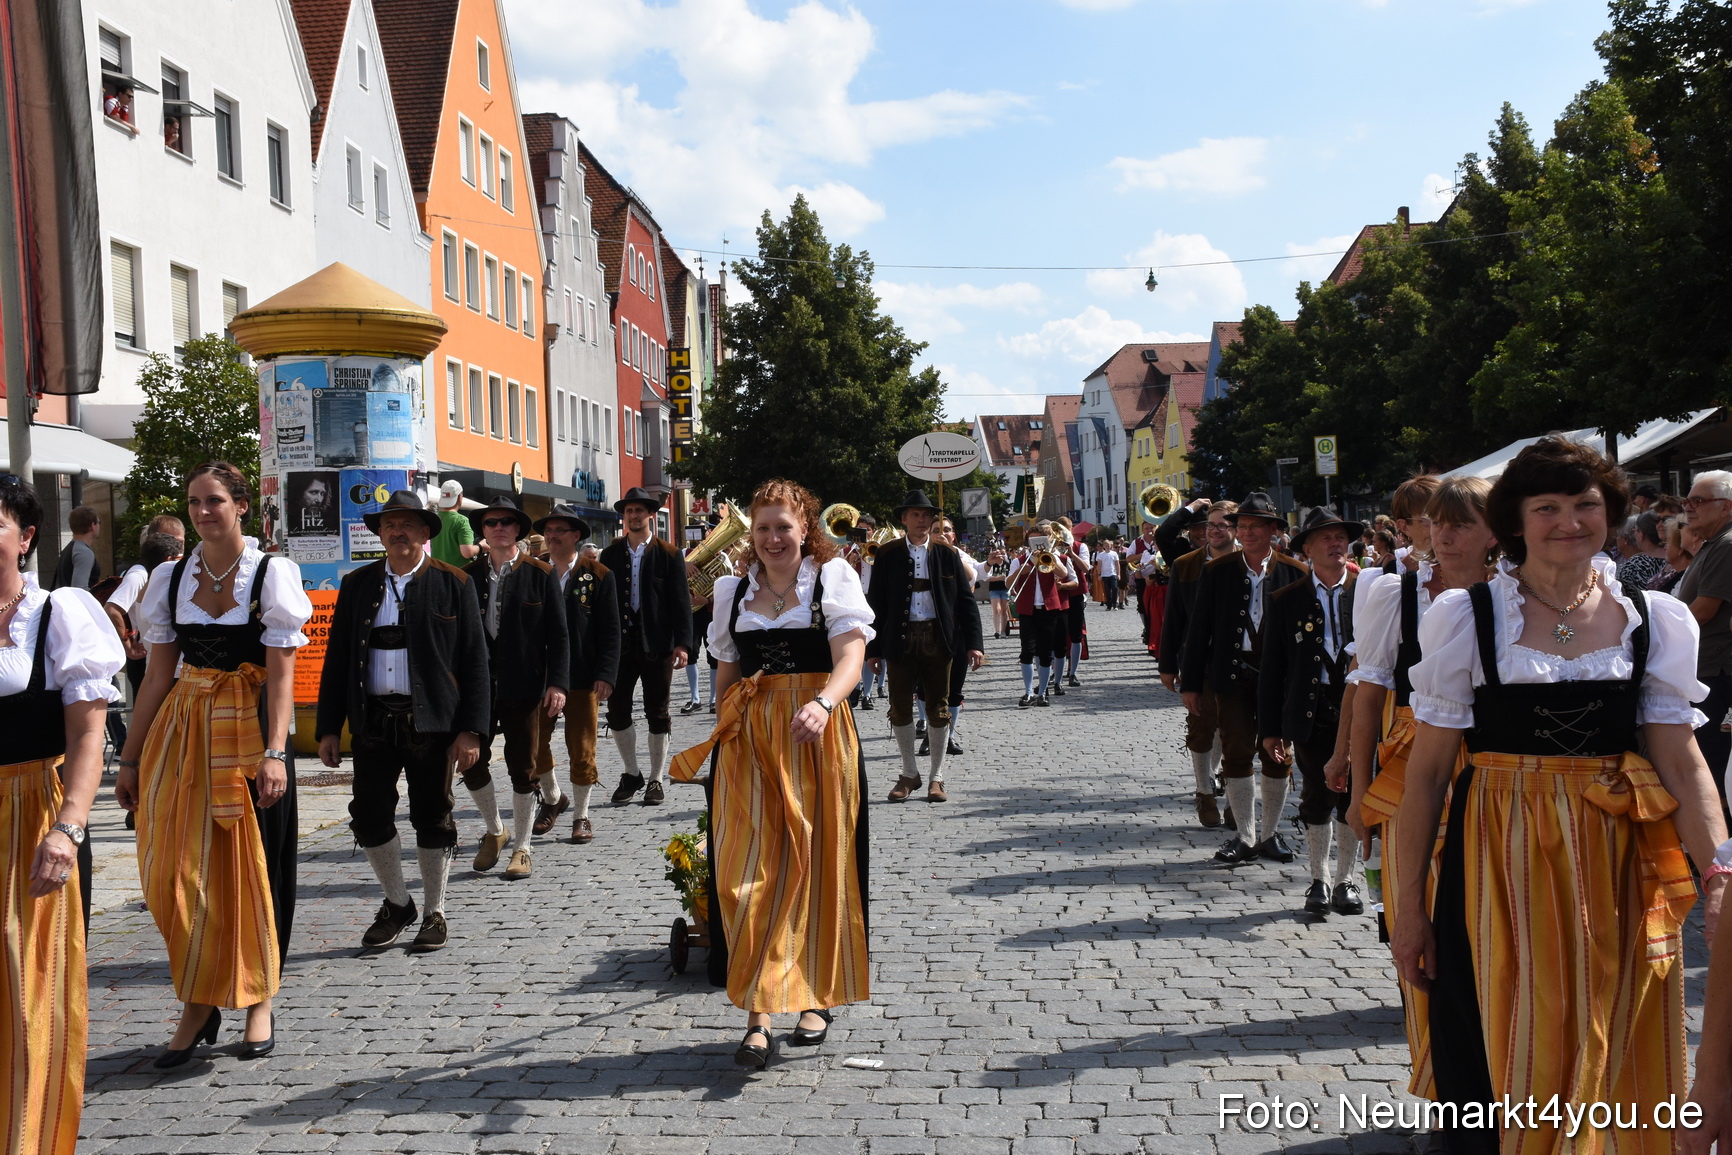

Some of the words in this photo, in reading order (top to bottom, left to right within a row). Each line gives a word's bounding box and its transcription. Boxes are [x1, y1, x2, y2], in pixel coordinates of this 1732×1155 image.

[334, 367, 371, 379] CHRISTIAN
[334, 379, 369, 388] SPRINGER
[670, 350, 693, 464] HOTEL
[350, 483, 390, 505] G6
